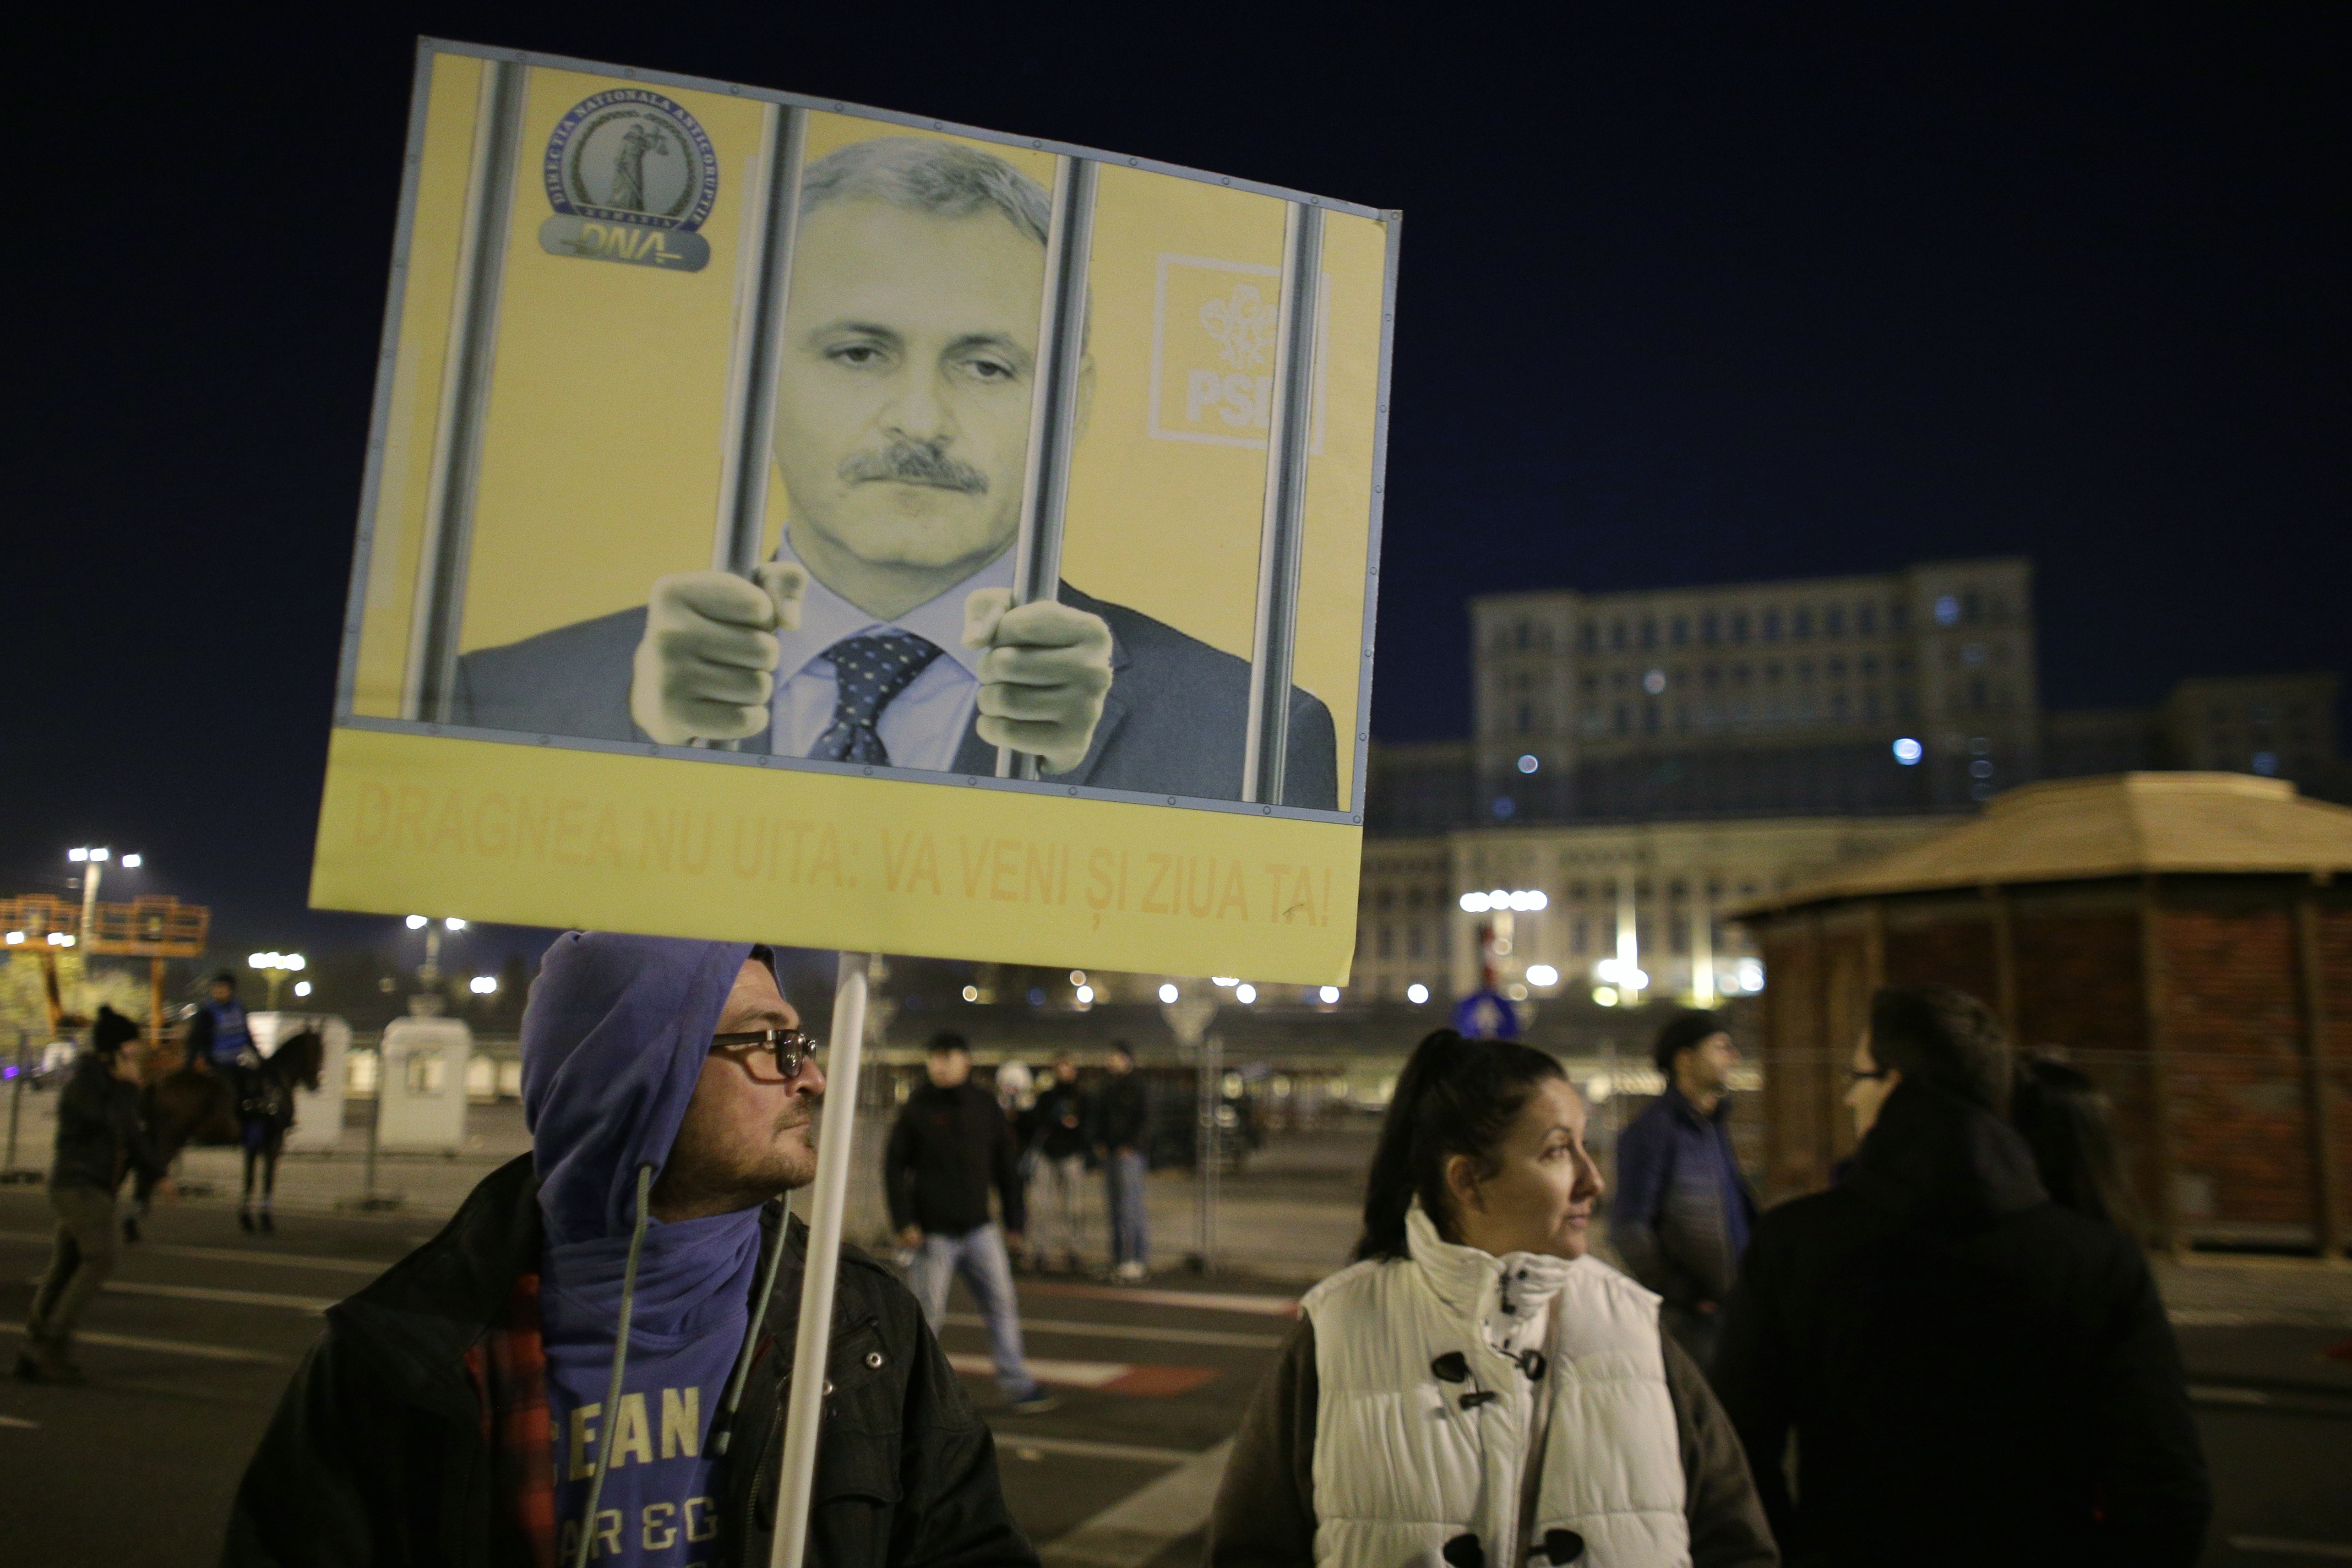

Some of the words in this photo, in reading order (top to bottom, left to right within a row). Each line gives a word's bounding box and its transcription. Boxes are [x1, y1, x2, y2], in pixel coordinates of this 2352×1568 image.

[573, 223, 683, 263] DNA
[355, 780, 623, 868] DRAGNEA
[638, 809, 714, 877] NU
[732, 816, 858, 888] UITA:
[878, 828, 942, 897] VA
[959, 833, 1071, 906] VENI
[1142, 854, 1249, 921] ZIUA
[1265, 862, 1333, 928] TA!
[551, 1386, 700, 1487] EAN
